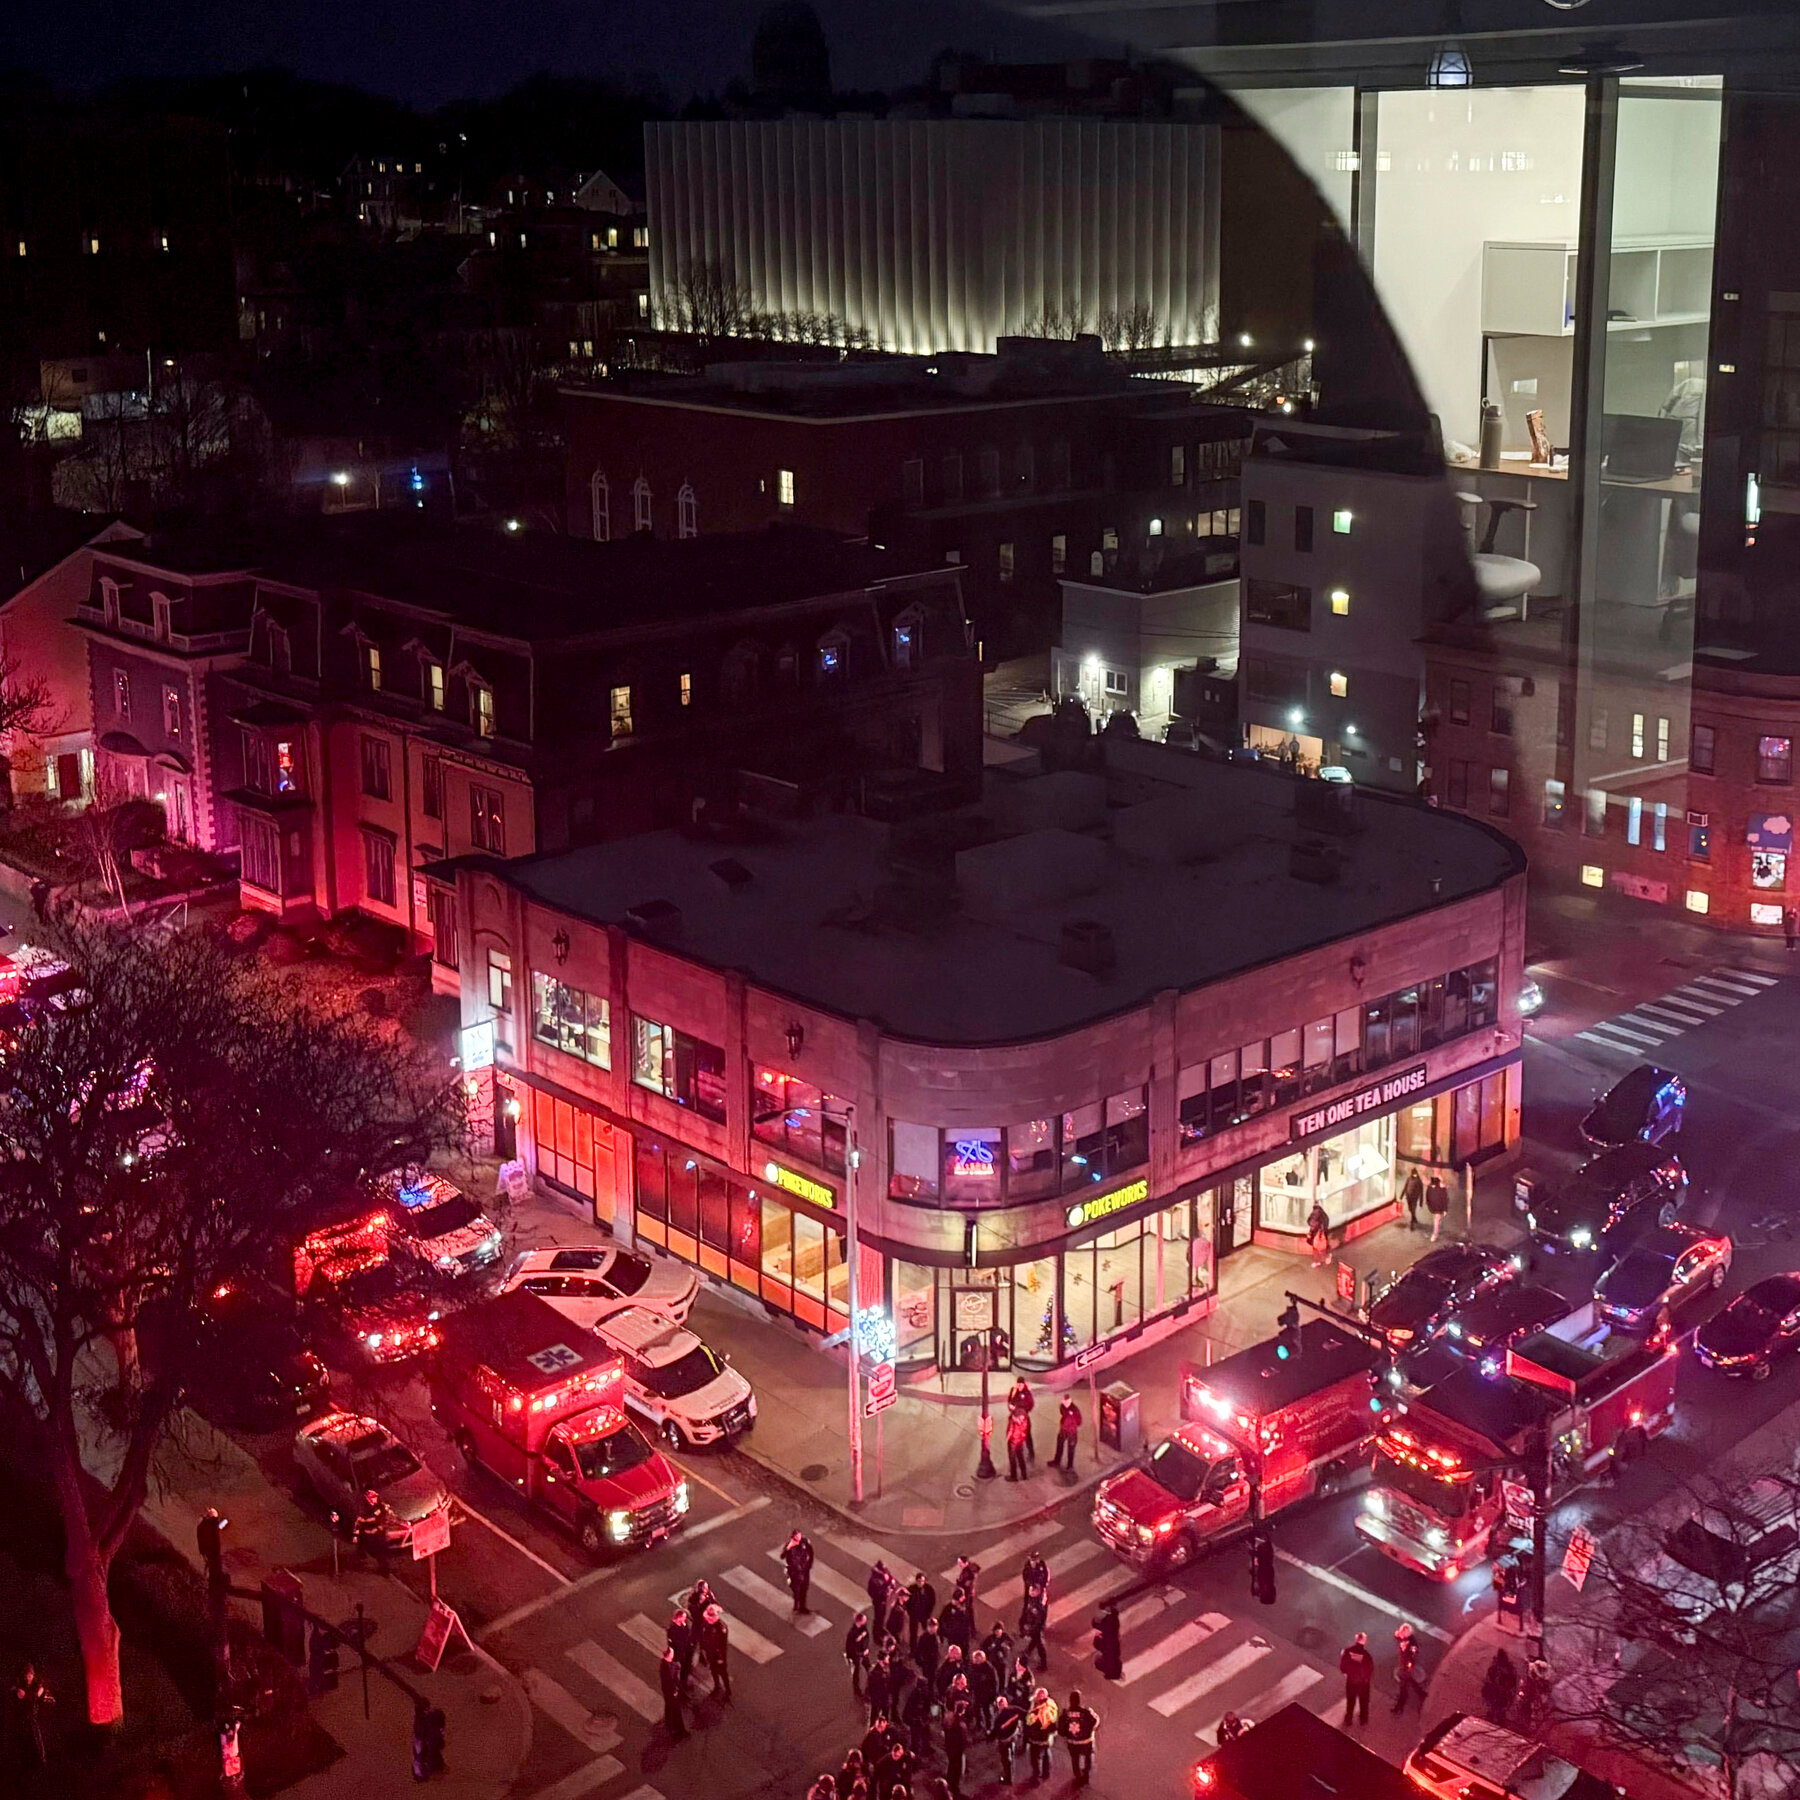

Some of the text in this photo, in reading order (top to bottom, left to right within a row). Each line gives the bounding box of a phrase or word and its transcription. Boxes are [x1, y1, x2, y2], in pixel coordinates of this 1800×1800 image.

[1297, 1069, 1426, 1137] TEN ONE TEA HOUSE
[1083, 1180, 1148, 1222] POKEWORKS
